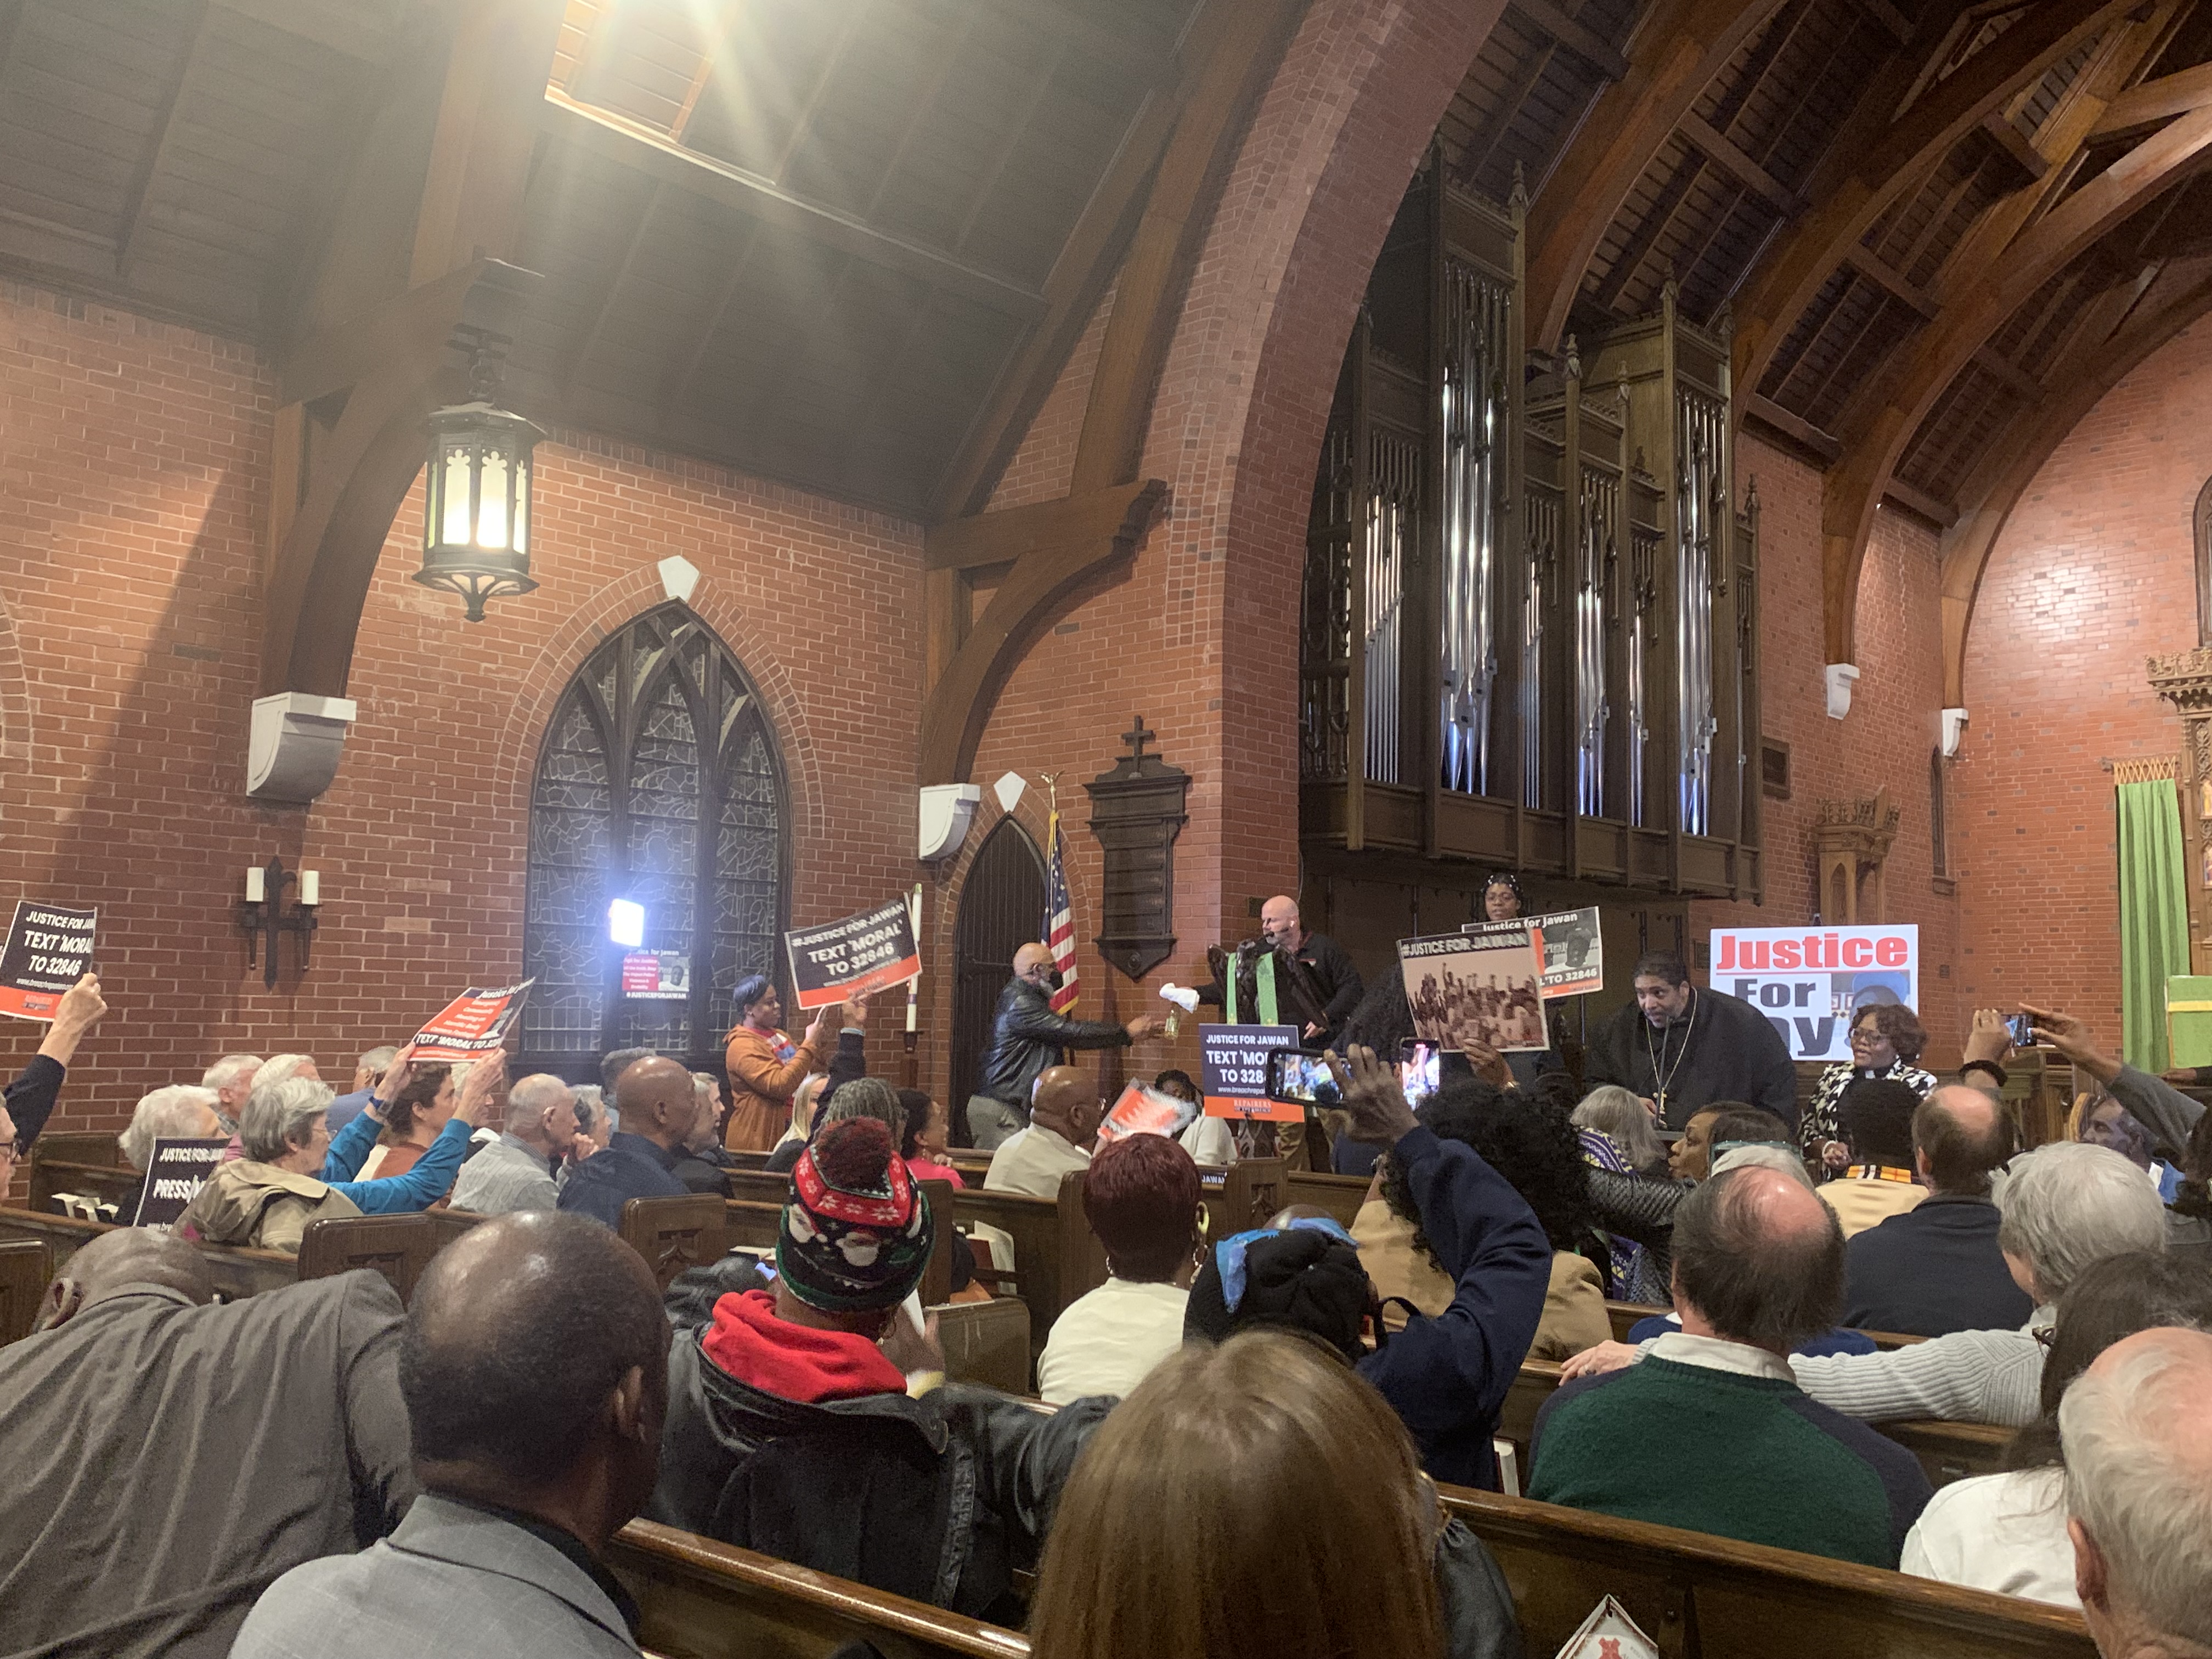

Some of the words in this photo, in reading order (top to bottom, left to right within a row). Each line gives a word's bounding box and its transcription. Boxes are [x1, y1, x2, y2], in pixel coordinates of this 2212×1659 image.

[26, 911, 68, 928] JUSTICE
[67, 918, 83, 929] FOR
[1523, 918, 1541, 928] for
[1542, 913, 1578, 928] Jawan
[24, 930, 60, 950] TEXT
[1401, 940, 1446, 956] #JUSTICE
[1445, 938, 1471, 951] FOR
[808, 943, 846, 963] TEXT
[1717, 933, 1908, 969] Justice
[28, 955, 47, 972] TO
[46, 957, 82, 977] 32846
[825, 961, 849, 975] TO
[1565, 968, 1598, 981] 32846
[1735, 979, 1816, 1007] For
[416, 1034, 439, 1045] TEXT
[1206, 1035, 1239, 1045] JUSTICE
[1239, 1035, 1256, 1045] FOR
[1257, 1036, 1289, 1046] JAWAN
[1206, 1050, 1238, 1065] TEXT
[1220, 1069, 1238, 1083] TO
[1240, 1069, 1267, 1084] 328
[159, 1147, 192, 1163] JUSTICE
